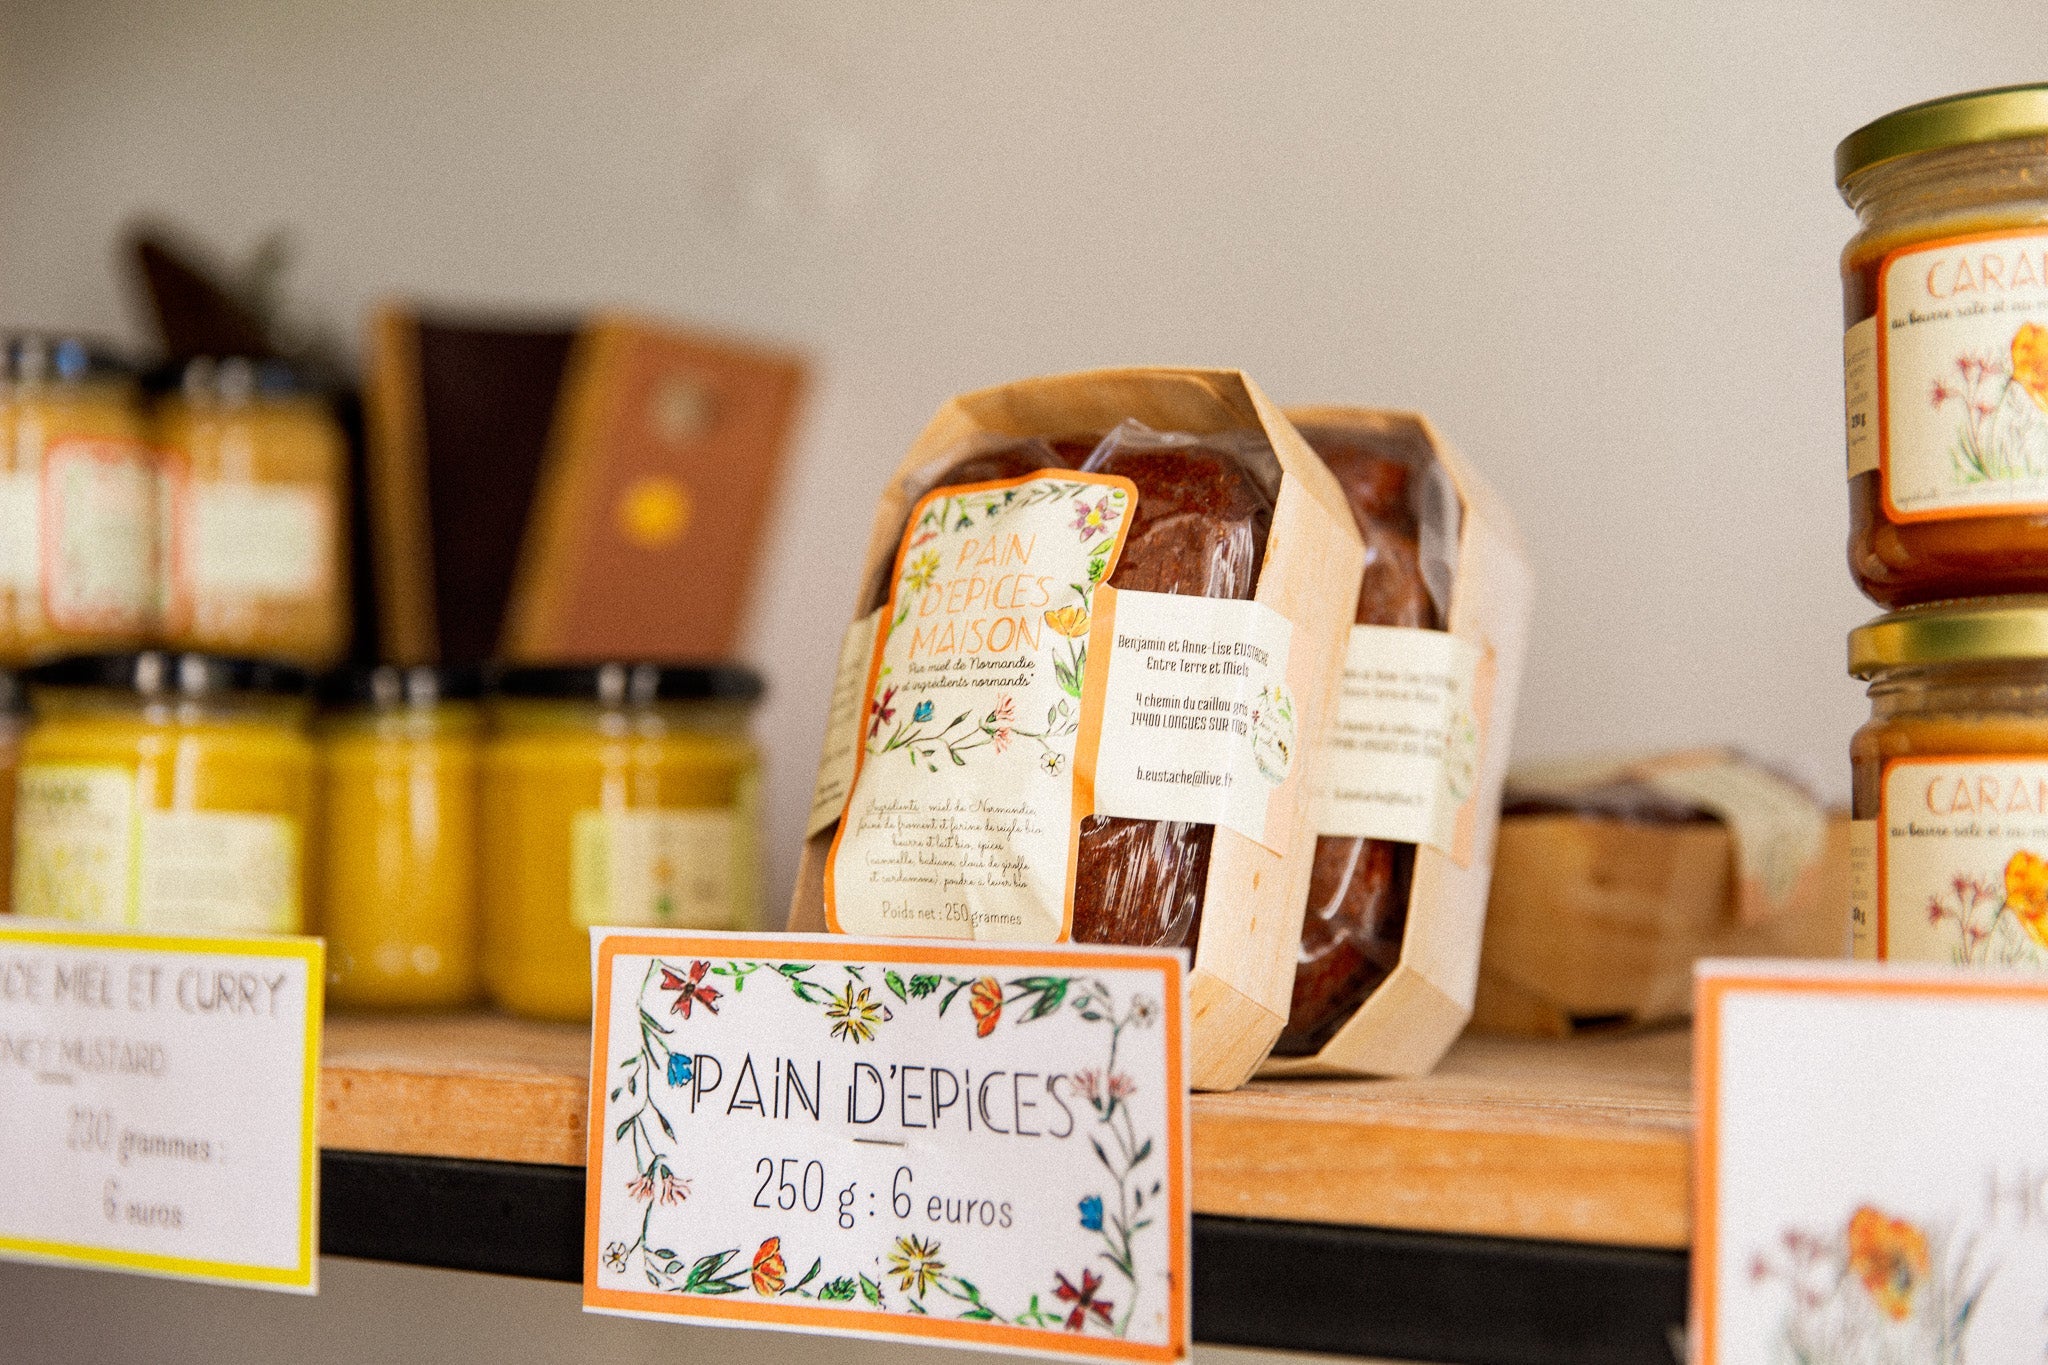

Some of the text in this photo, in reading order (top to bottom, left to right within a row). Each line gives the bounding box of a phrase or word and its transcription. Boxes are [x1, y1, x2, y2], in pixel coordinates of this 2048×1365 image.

[1927, 250, 2048, 299] CARA
[908, 616, 1042, 660] MAISON
[1118, 634, 1166, 652] Benjamin
[1168, 639, 1179, 652] et
[1181, 639, 1232, 656] Anne-Lise
[927, 658, 951, 672] miel
[953, 657, 966, 671] de
[969, 655, 1036, 670] Normandie
[1146, 656, 1177, 672] Entre
[1179, 658, 1207, 674] Terre
[1209, 662, 1221, 675] et
[1136, 692, 1142, 706] 4
[1144, 693, 1181, 709] chemin
[1183, 695, 1195, 710] du
[1197, 696, 1231, 712] caillou
[1131, 711, 1161, 728] 14400
[1163, 713, 1207, 731] LONGUES
[1209, 716, 1229, 732] SUR
[1926, 774, 2048, 817] CARA
[882, 900, 915, 919] Poids
[917, 907, 937, 919] net
[945, 903, 969, 922] 250
[970, 909, 1022, 928] grammes
[176, 965, 287, 1018] CURRY
[118, 1127, 213, 1167] grammes
[753, 1157, 825, 1212] 250
[838, 1183, 858, 1229] g
[892, 1166, 913, 1219] 6
[927, 1195, 1013, 1229] euros
[125, 1201, 184, 1229] euros
